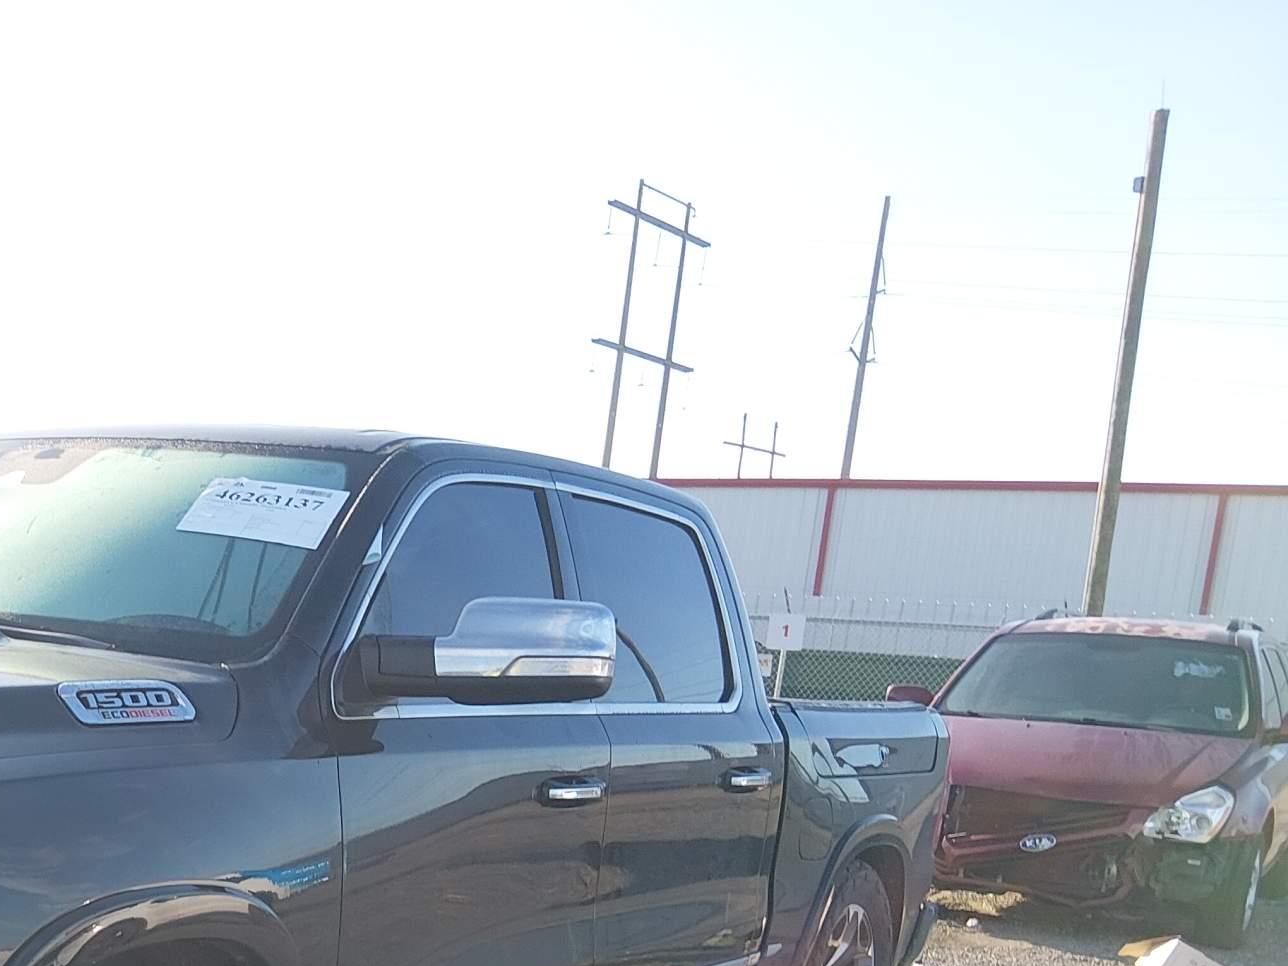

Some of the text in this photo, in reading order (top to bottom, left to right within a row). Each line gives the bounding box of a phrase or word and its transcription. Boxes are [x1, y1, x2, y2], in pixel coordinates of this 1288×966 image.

[215, 489, 325, 512] 46263137
[782, 624, 790, 638] 1
[80, 690, 172, 709] 1500
[101, 709, 177, 720] ECODIESEL
[1021, 836, 1053, 849] KIA
